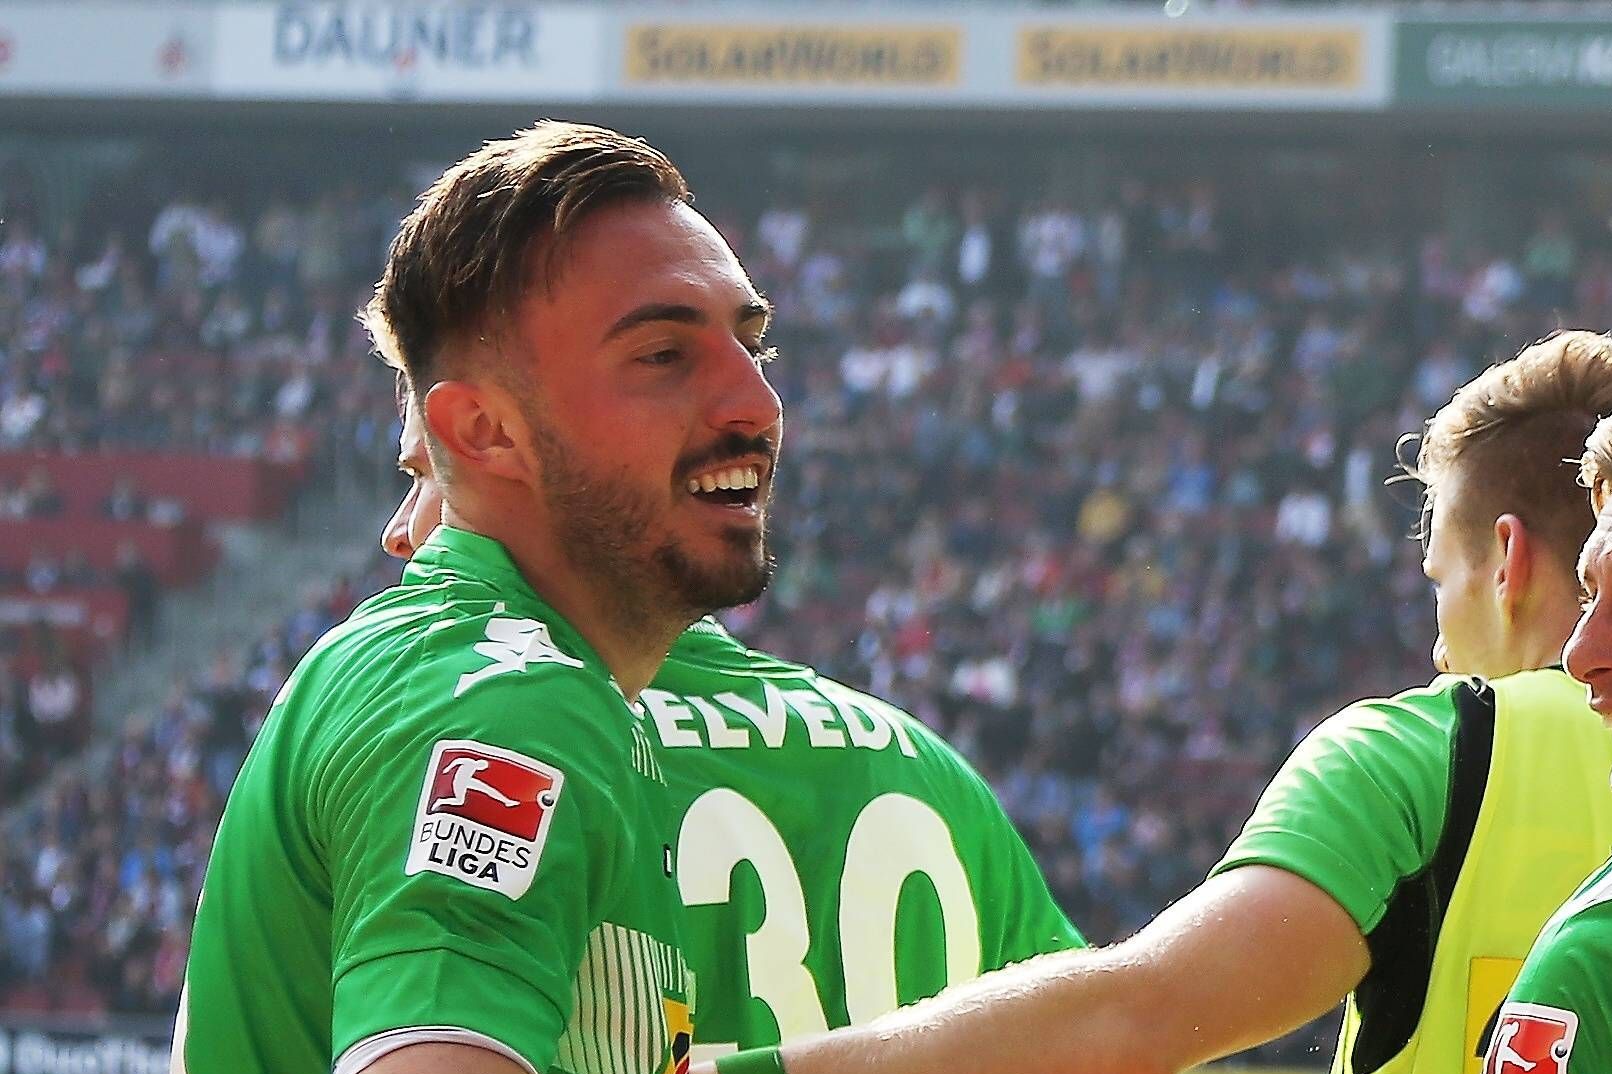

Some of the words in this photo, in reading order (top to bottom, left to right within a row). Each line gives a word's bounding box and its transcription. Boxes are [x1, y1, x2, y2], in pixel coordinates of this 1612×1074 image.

[275, 4, 540, 66] DAUNER
[640, 679, 918, 759] ELVEDI
[420, 819, 532, 869] BUNDES
[428, 842, 500, 883] LIGA
